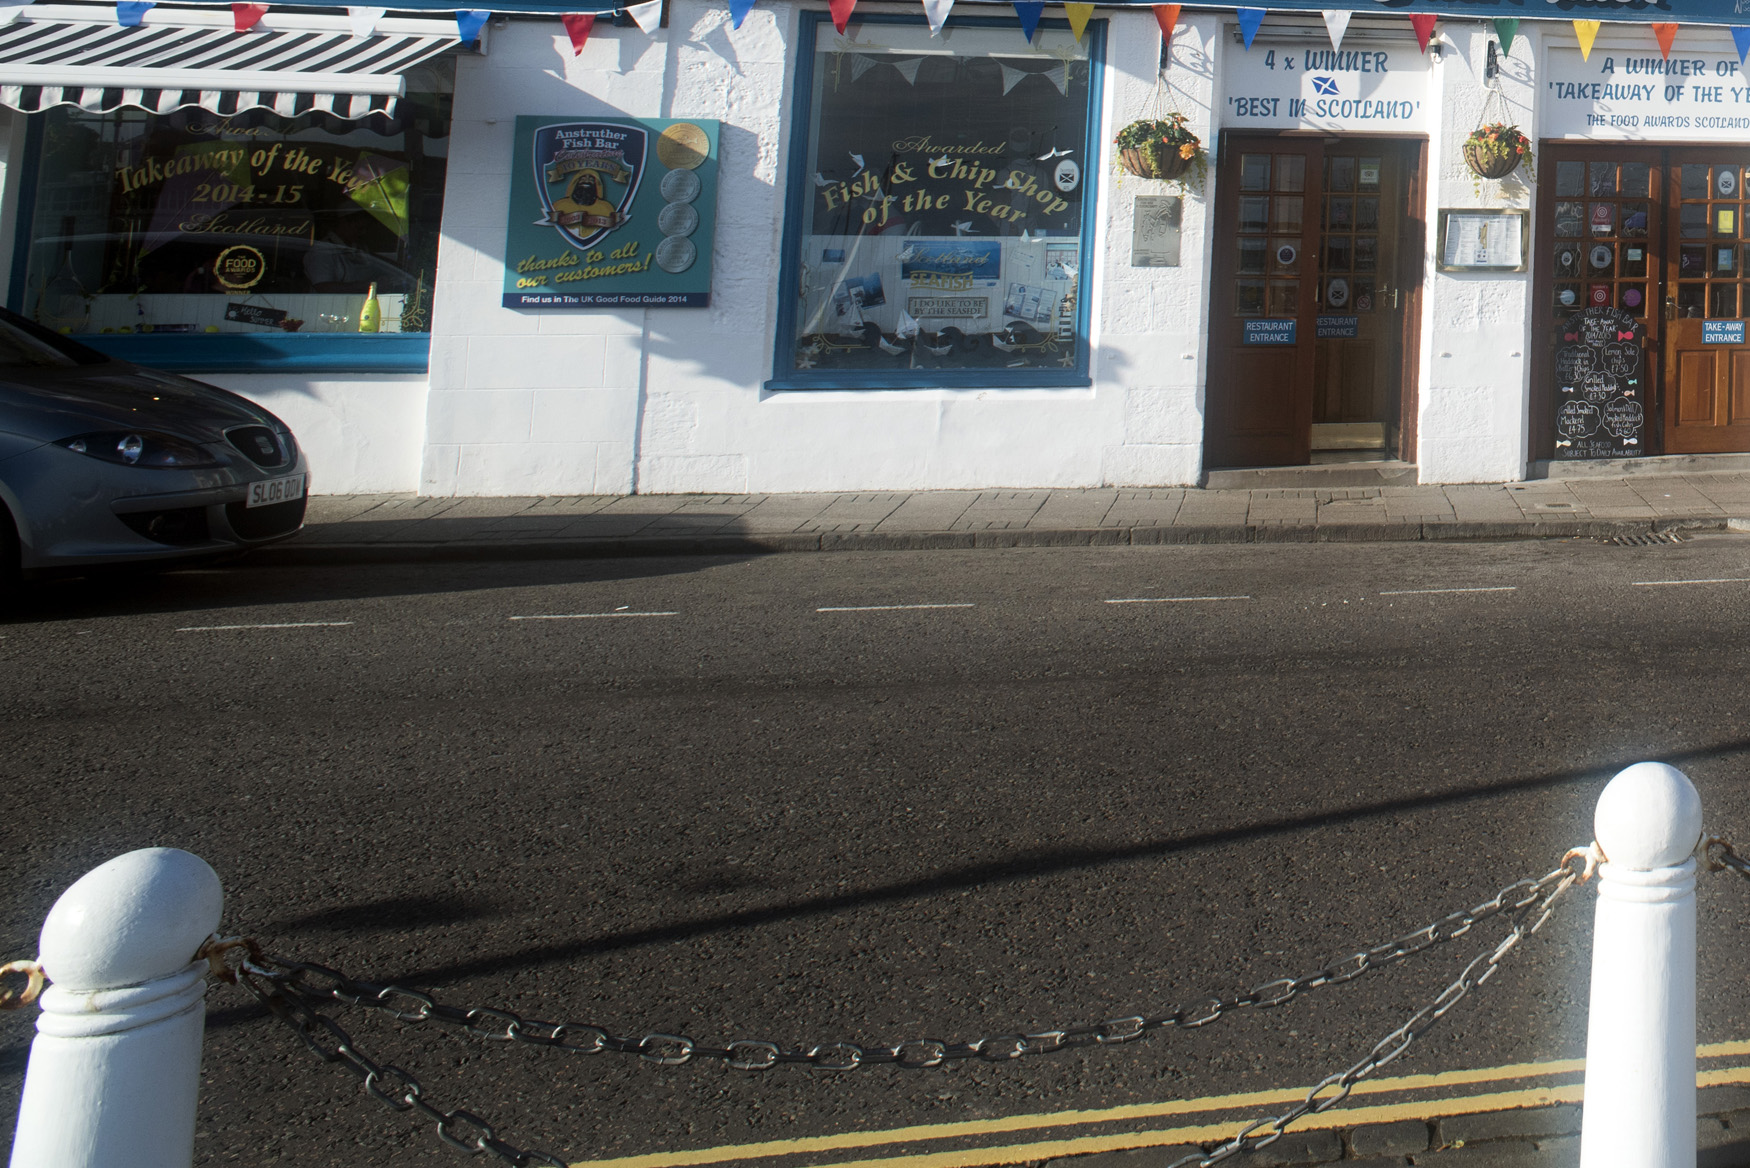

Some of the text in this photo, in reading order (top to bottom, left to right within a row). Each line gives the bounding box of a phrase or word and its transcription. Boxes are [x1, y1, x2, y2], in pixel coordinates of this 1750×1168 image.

[1264, 49, 1389, 73] 4 x WINNER
[1601, 57, 1740, 77] A WINNER OF
[1663, 84, 1685, 102] OF
[1692, 85, 1723, 103] THE
[1288, 98, 1306, 118] IN
[1586, 113, 1750, 129] THE FOOD AWARDS SCOTLAND
[555, 129, 627, 141] Anstruther
[562, 139, 619, 149] Fish Bar
[892, 135, 1006, 155] Awarded
[114, 147, 245, 194] Takeaway
[250, 143, 282, 176] of
[283, 146, 322, 175] the
[576, 159, 616, 171] YEARS
[821, 158, 1069, 215] Fish & Chip Shop
[862, 189, 1028, 228] of the Year
[178, 213, 311, 236] Scotland
[225, 259, 256, 268] FOOD
[516, 242, 639, 273] thanks to all
[516, 253, 653, 289] our customers!
[909, 272, 974, 289] SEAFISH
[521, 295, 540, 303] Find
[553, 295, 562, 303] in
[563, 295, 579, 303] The
[580, 295, 594, 303] UK
[596, 295, 618, 303] Good
[620, 295, 641, 303] Food
[643, 295, 667, 303] Guide
[668, 295, 687, 303] 2014
[919, 299, 935, 307] DO
[936, 299, 956, 307] LIKE
[958, 299, 972, 307] TO
[947, 307, 983, 315] SEASIDE
[1246, 322, 1294, 331] RESTAURANT
[1622, 314, 1639, 332] BAR
[1704, 322, 1743, 332] TAKE-AWAY
[1250, 333, 1289, 342] ENTRANCE
[1317, 328, 1355, 336] ENTRANCE
[1705, 334, 1742, 343] ENTRANCE
